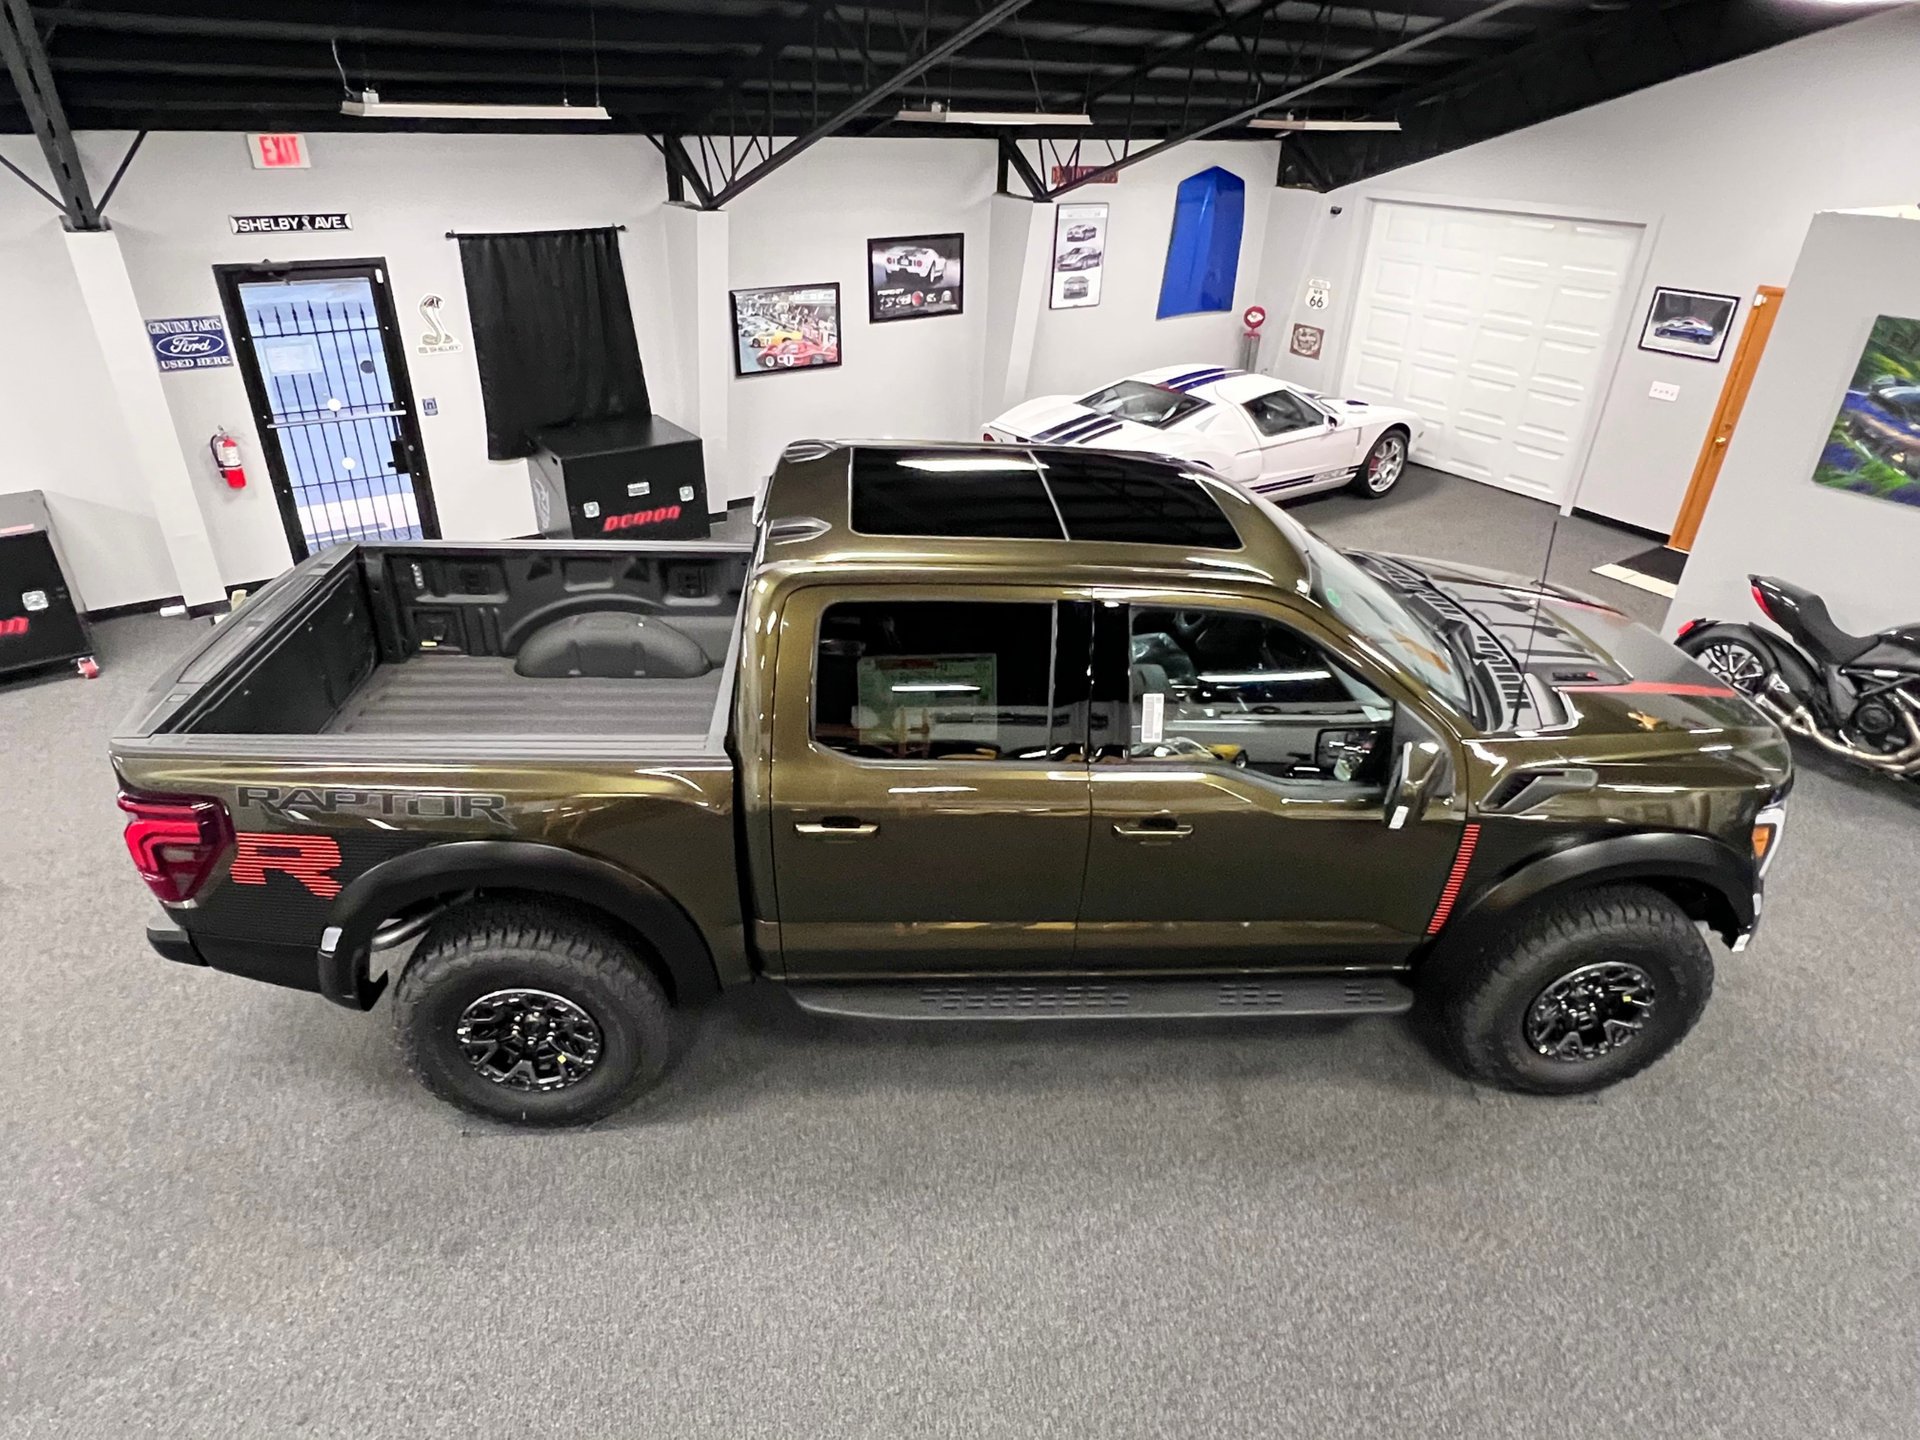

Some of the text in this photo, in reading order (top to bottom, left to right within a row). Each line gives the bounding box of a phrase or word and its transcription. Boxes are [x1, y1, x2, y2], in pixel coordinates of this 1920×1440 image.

[259, 136, 300, 166] EXIT
[238, 216, 345, 231] SHELBY AVE.
[1309, 295, 1324, 308] 66
[147, 318, 223, 335] GENUINE PARTS
[170, 336, 211, 353] Ford
[160, 356, 231, 370] USED HERE
[236, 786, 517, 829] RAPTOR
